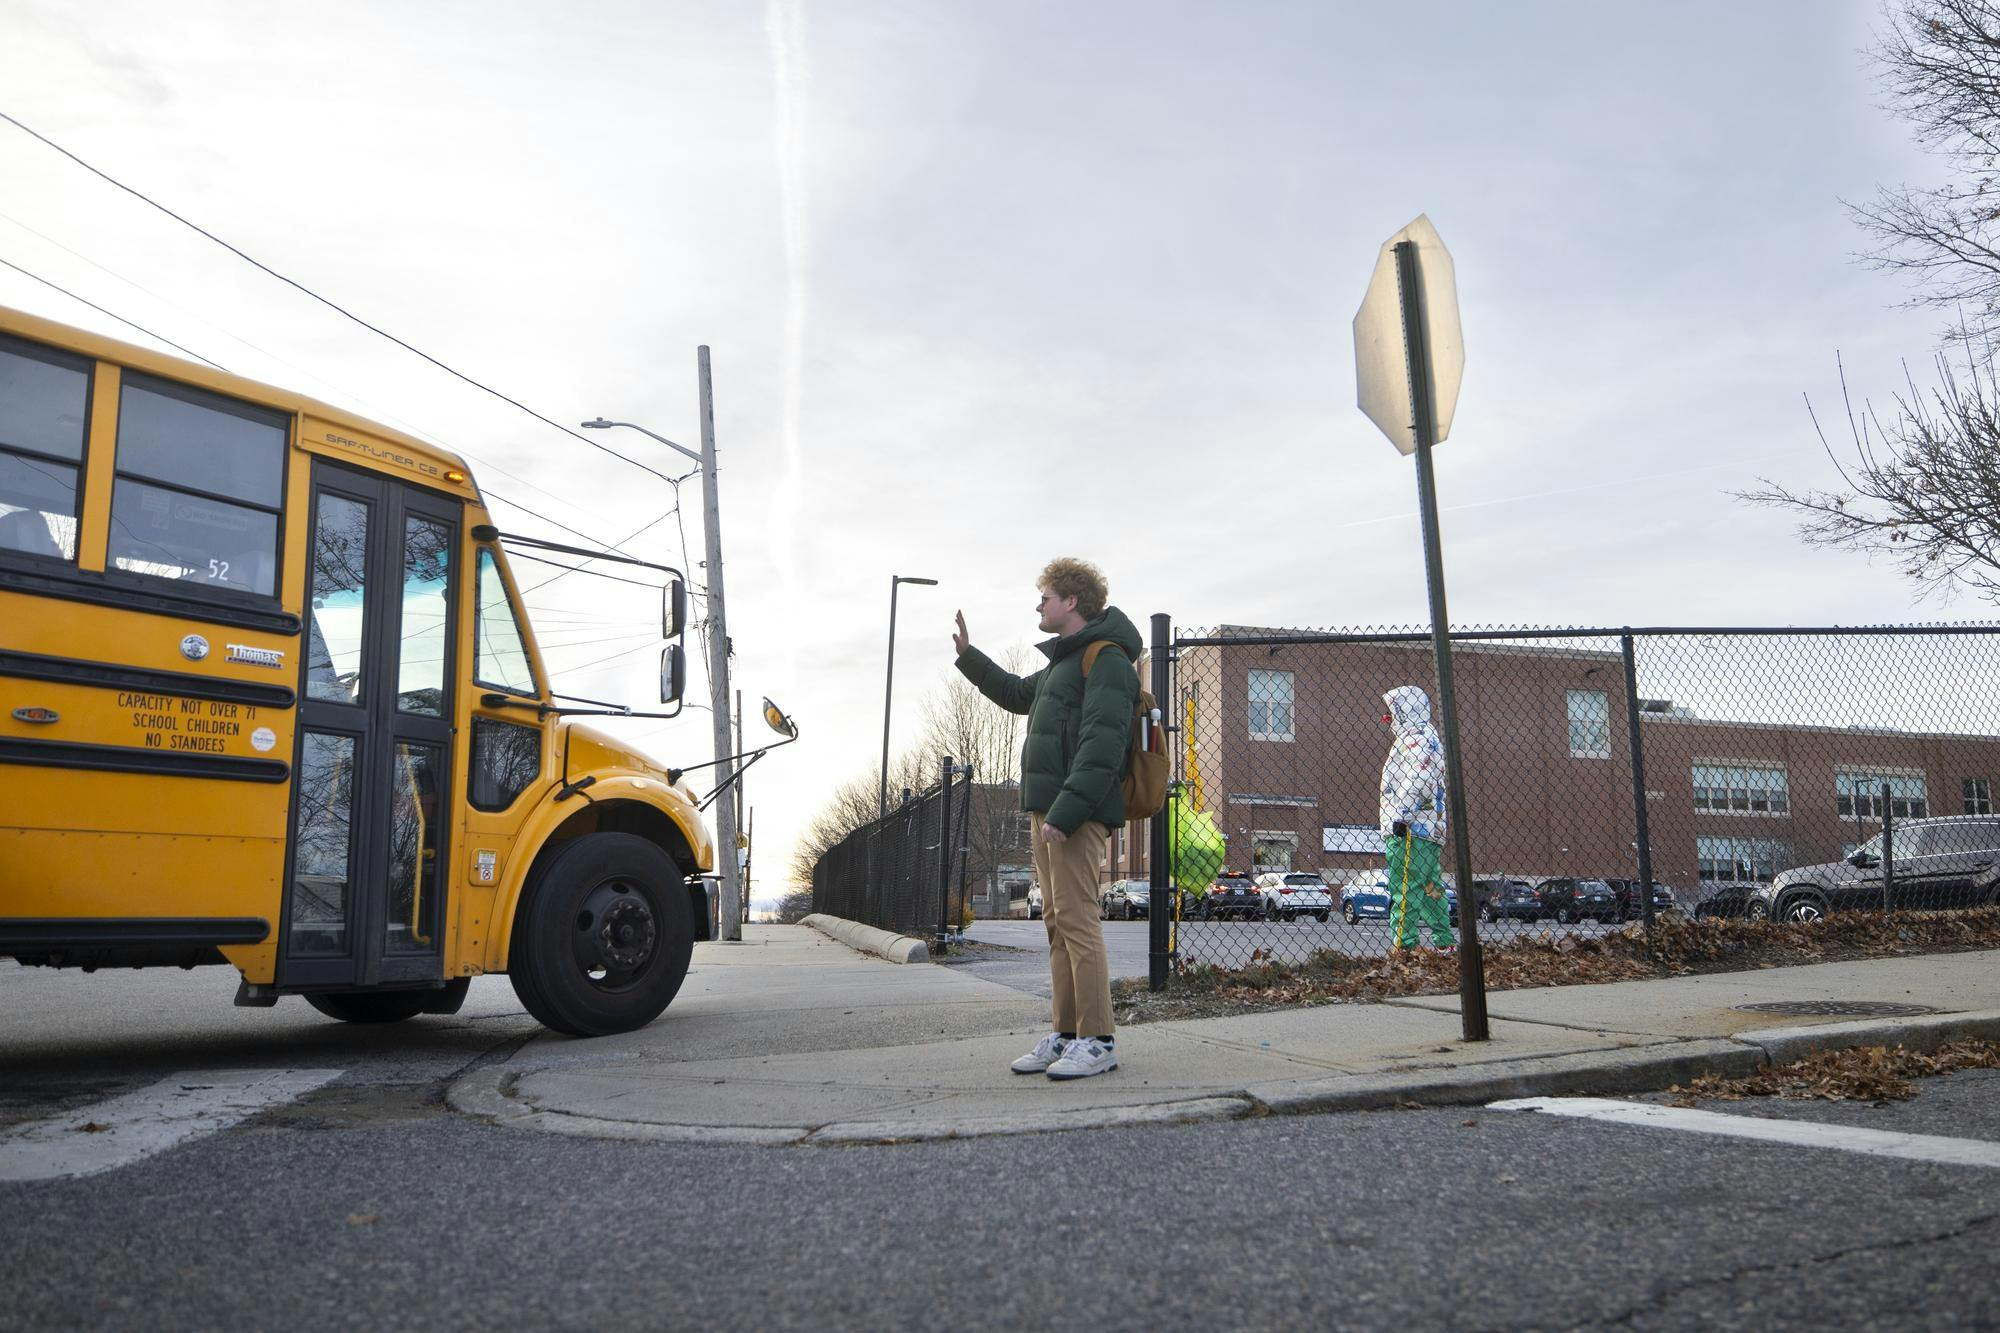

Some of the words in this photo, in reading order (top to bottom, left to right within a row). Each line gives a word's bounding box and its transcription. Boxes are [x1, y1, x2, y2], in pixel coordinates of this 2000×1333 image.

[419, 463, 438, 475] C2
[208, 558, 229, 580] 52
[226, 644, 284, 663] Thomas
[118, 692, 173, 711] CAPACITY
[181, 700, 203, 714] NOT
[210, 702, 237, 718] OVER
[246, 705, 256, 720] 71
[133, 713, 178, 730] SCHOOL
[187, 718, 239, 736] CHILDREN
[146, 733, 162, 747] NO
[170, 734, 225, 752] STANDEES
